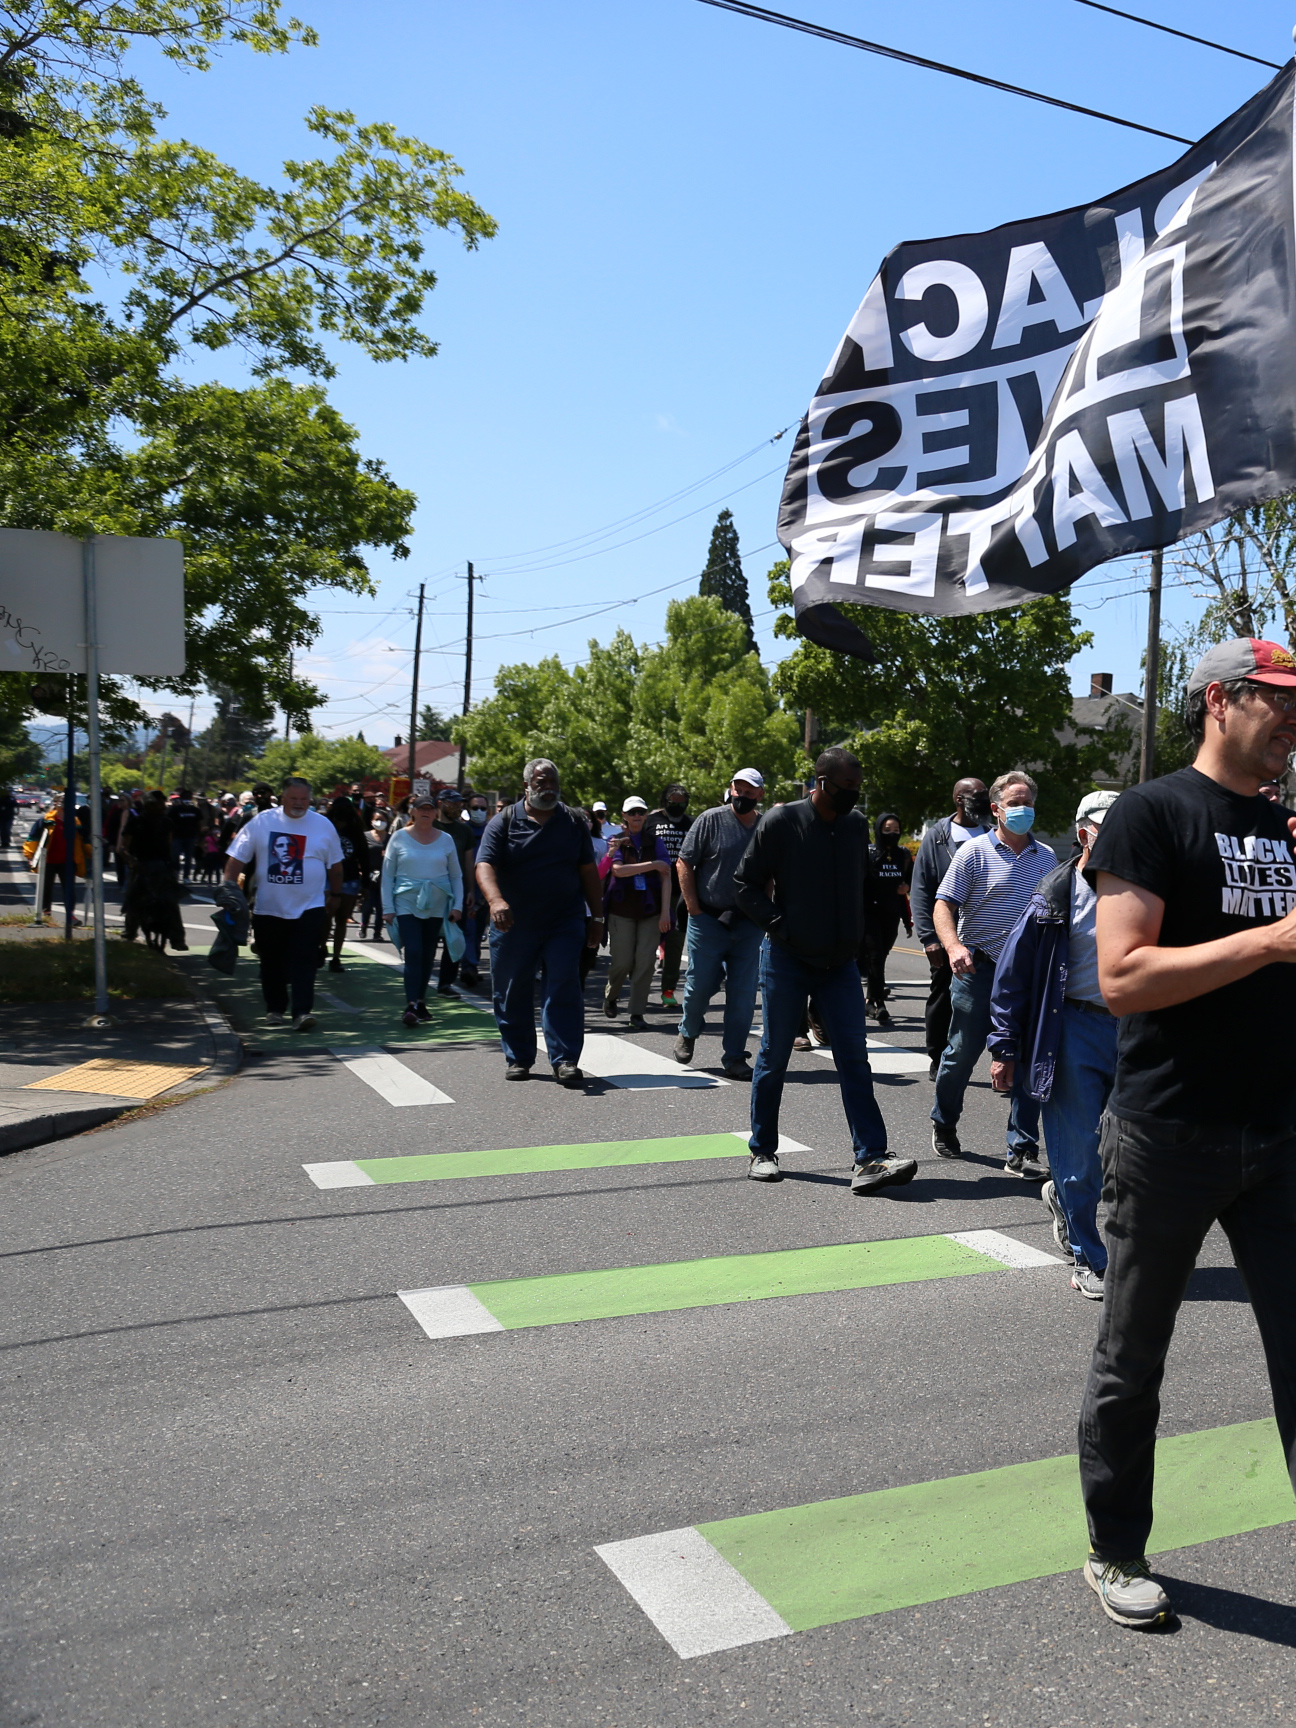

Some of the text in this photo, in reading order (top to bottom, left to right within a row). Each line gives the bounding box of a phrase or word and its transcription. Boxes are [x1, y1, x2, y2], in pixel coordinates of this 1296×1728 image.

[1214, 832, 1294, 864] BLACK
[269, 874, 302, 884] HOPE
[1224, 860, 1294, 888] LIVES
